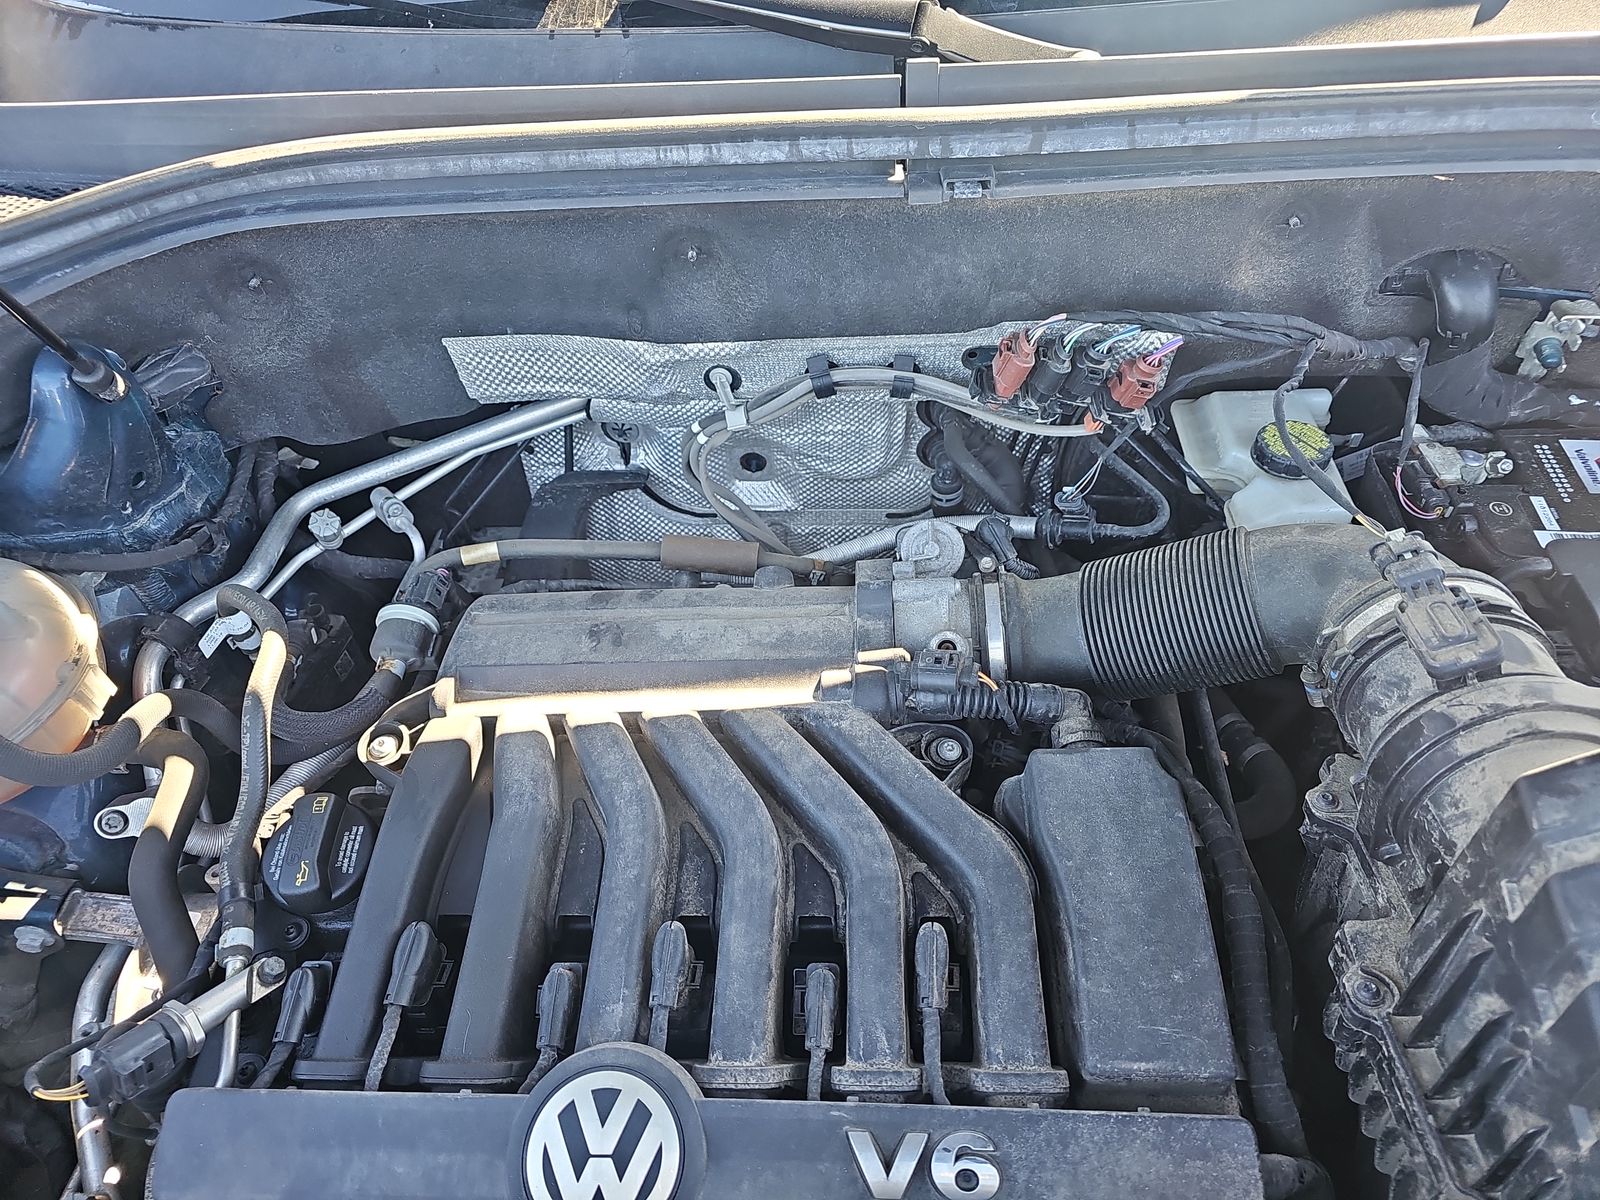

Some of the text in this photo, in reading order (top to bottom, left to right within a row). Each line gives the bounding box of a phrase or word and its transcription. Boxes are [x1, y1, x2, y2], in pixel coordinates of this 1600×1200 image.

[1574, 448, 1600, 483] Valvoline
[527, 1071, 681, 1200] VW
[846, 1126, 1001, 1200] V6
